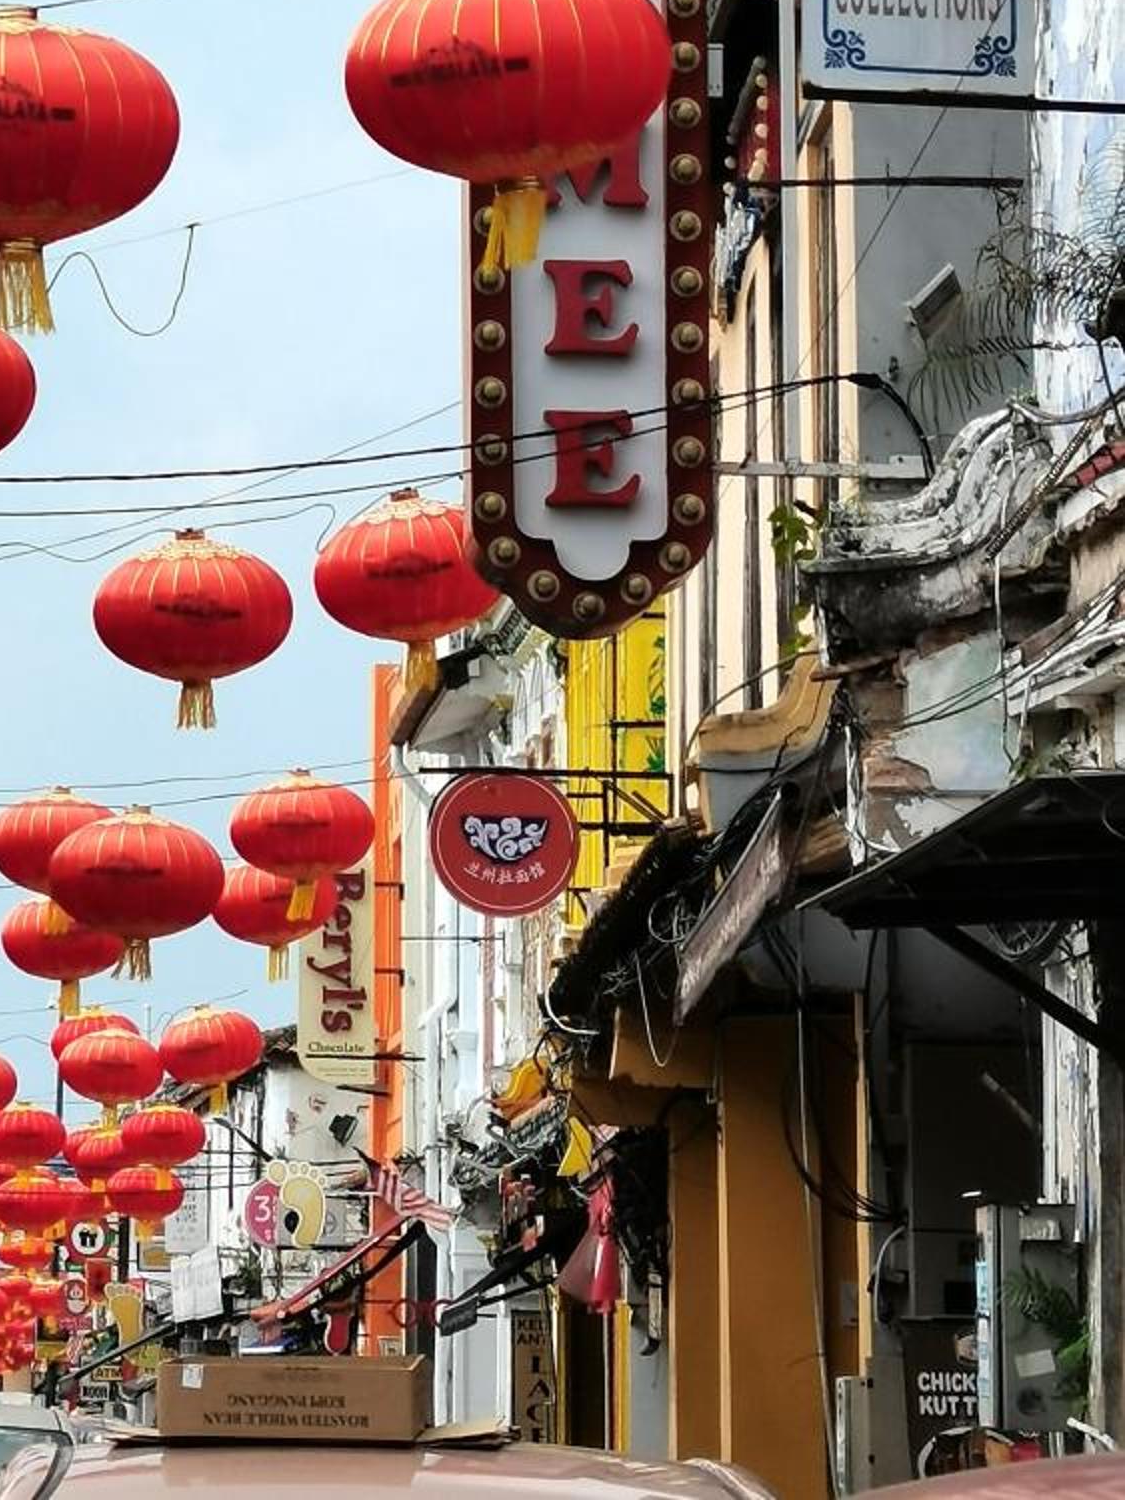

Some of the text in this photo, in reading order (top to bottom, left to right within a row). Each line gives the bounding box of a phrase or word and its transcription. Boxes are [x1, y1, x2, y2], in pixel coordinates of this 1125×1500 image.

[306, 868, 368, 1033] Beryl's
[308, 1041, 366, 1053] Chocolate
[917, 1371, 976, 1393] CHICK
[227, 1394, 307, 1408] PANGGANG
[203, 1412, 370, 1428] ROASTED WHOLE BEAN
